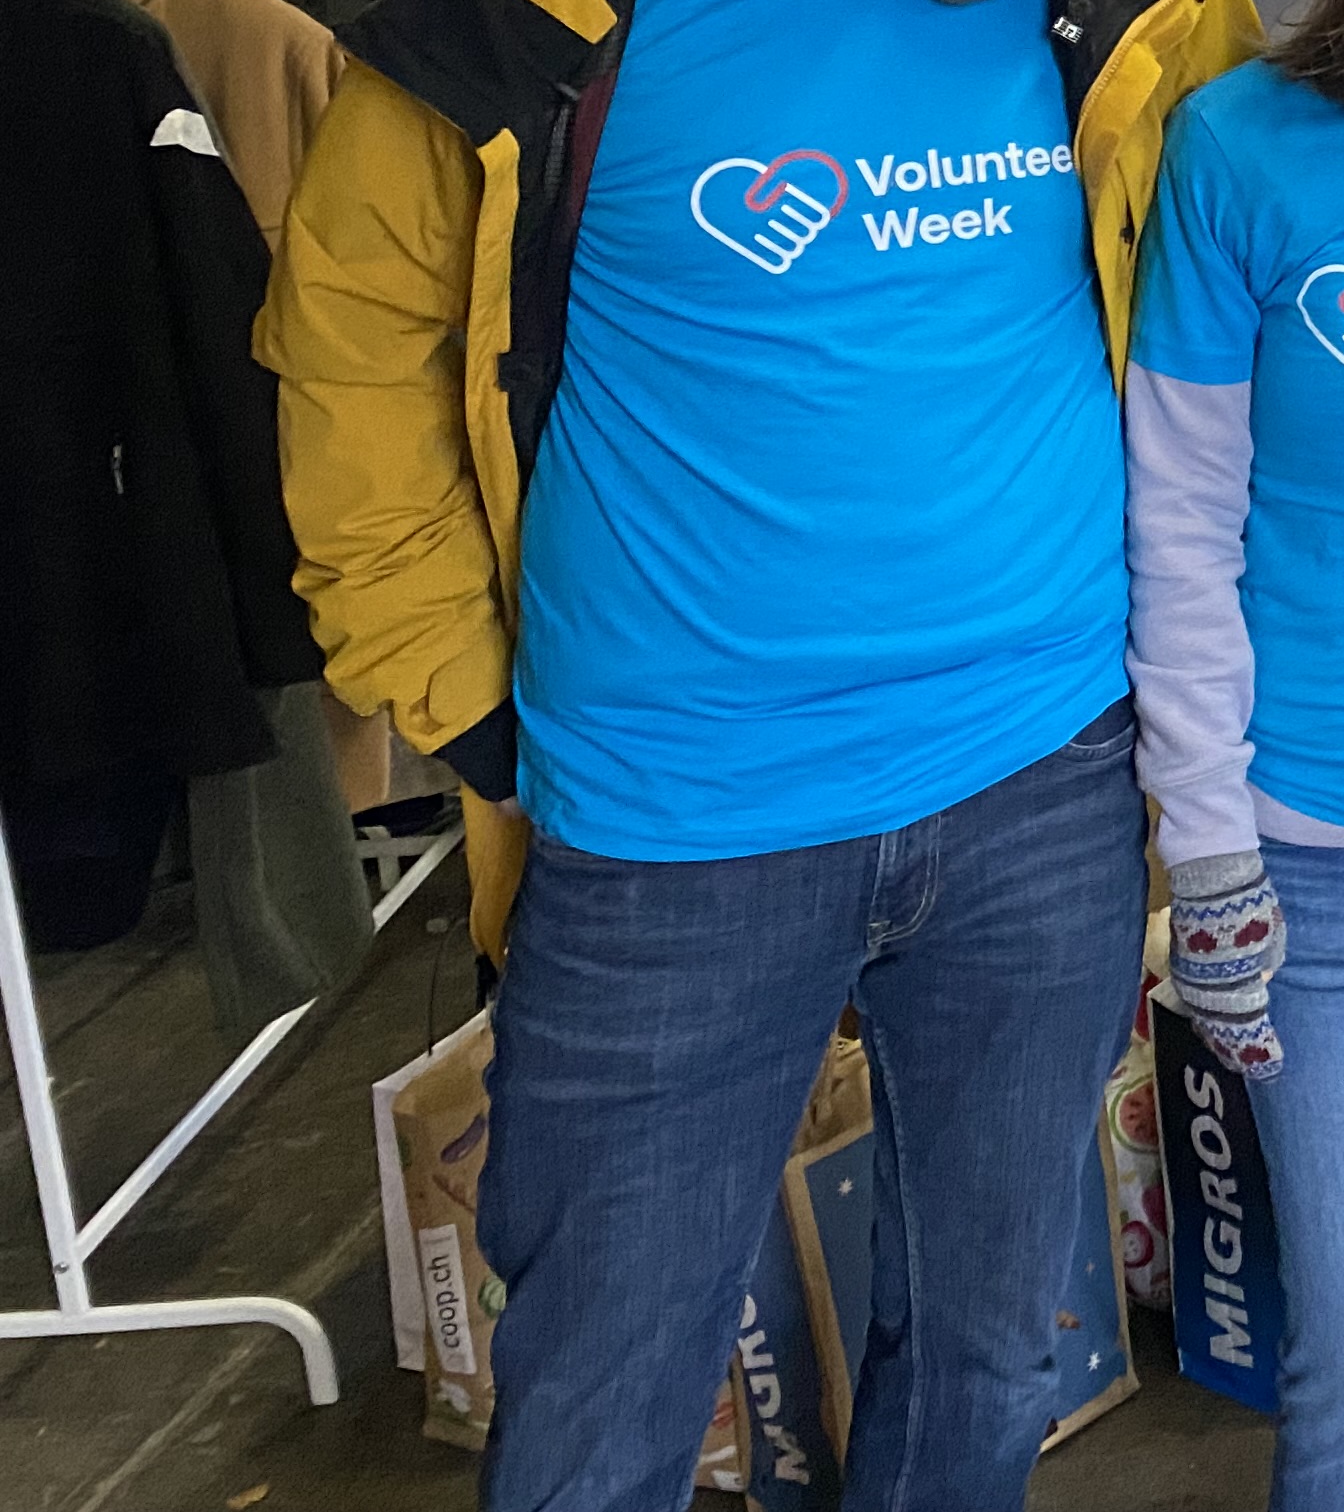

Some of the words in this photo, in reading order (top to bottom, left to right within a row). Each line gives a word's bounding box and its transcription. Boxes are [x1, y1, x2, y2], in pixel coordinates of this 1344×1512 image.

[855, 142, 1074, 197] Voluntee
[861, 197, 1014, 252] Week
[1184, 1064, 1255, 1368] MIGROS
[427, 1254, 461, 1349] coop.ch
